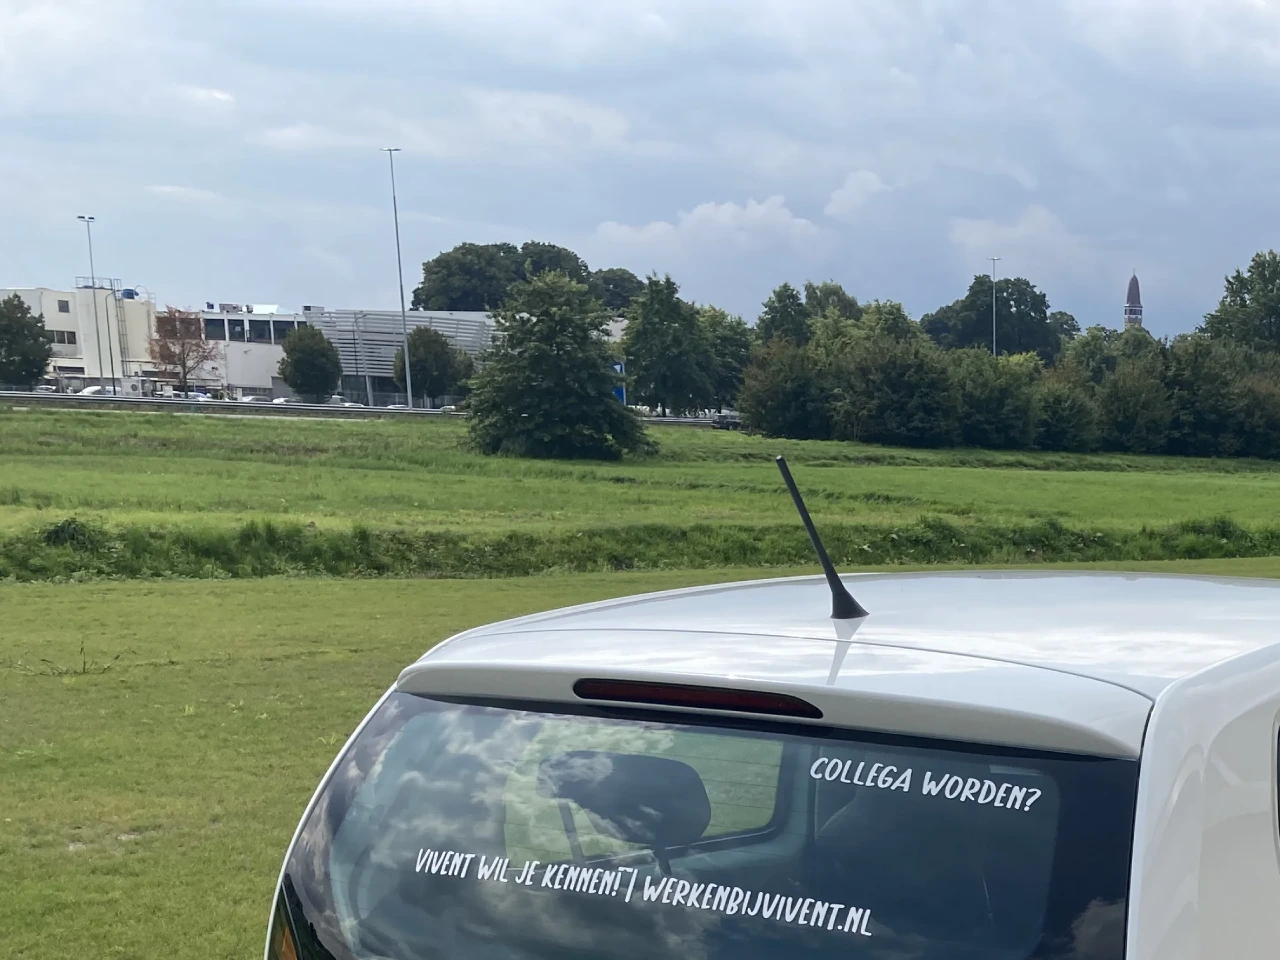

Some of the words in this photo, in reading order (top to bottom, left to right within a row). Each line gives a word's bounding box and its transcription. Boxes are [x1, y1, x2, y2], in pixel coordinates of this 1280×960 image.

[810, 757, 913, 792] COLLEGA
[922, 771, 1042, 812] WORDEN?
[415, 848, 476, 879] VIVENT
[477, 855, 509, 883] WIL
[515, 860, 541, 886] JE
[541, 864, 622, 897] KENNEN!
[643, 875, 873, 937] WERKENBIJVIVENT.NL
